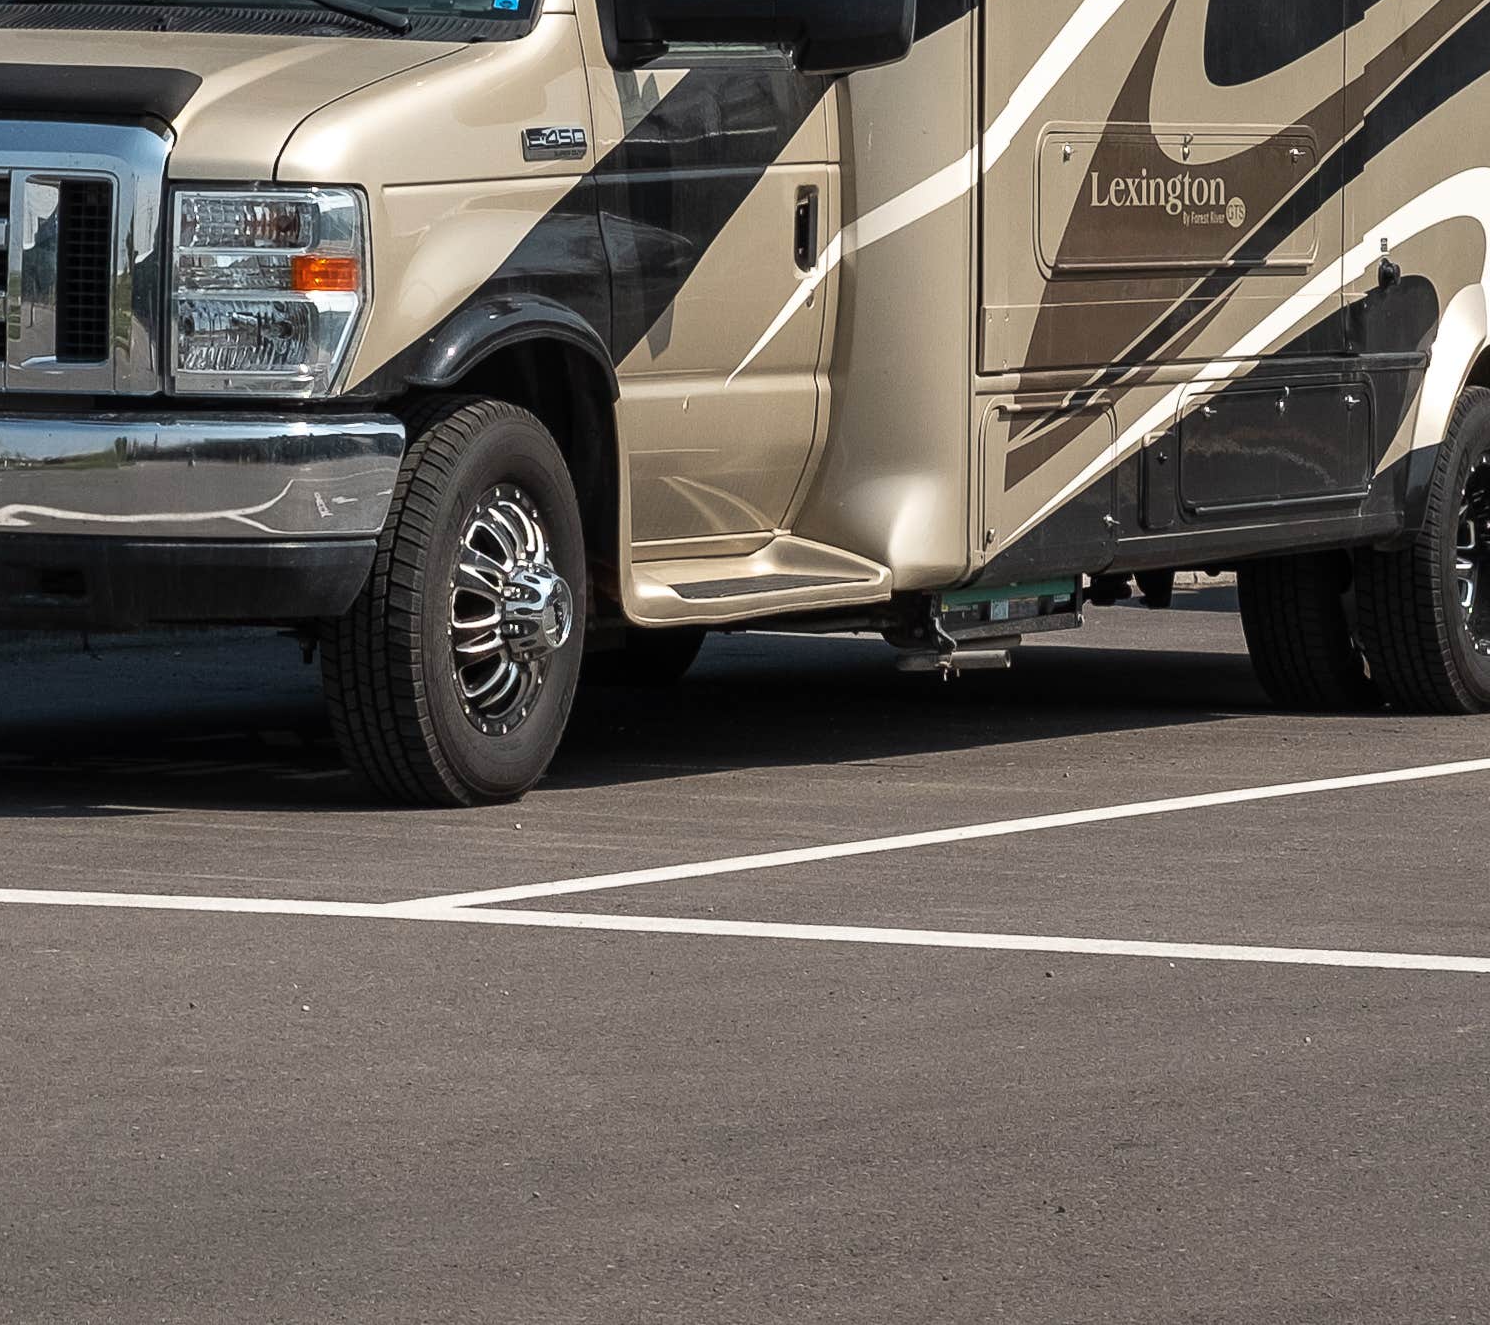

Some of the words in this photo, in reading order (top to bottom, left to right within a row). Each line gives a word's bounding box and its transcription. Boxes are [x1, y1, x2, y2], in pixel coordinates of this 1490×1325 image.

[1090, 168, 1225, 215] Lexington
[1183, 212, 1189, 226] By
[1192, 212, 1210, 225] Forest
[1211, 212, 1225, 224] River
[1227, 205, 1245, 221] GTS
